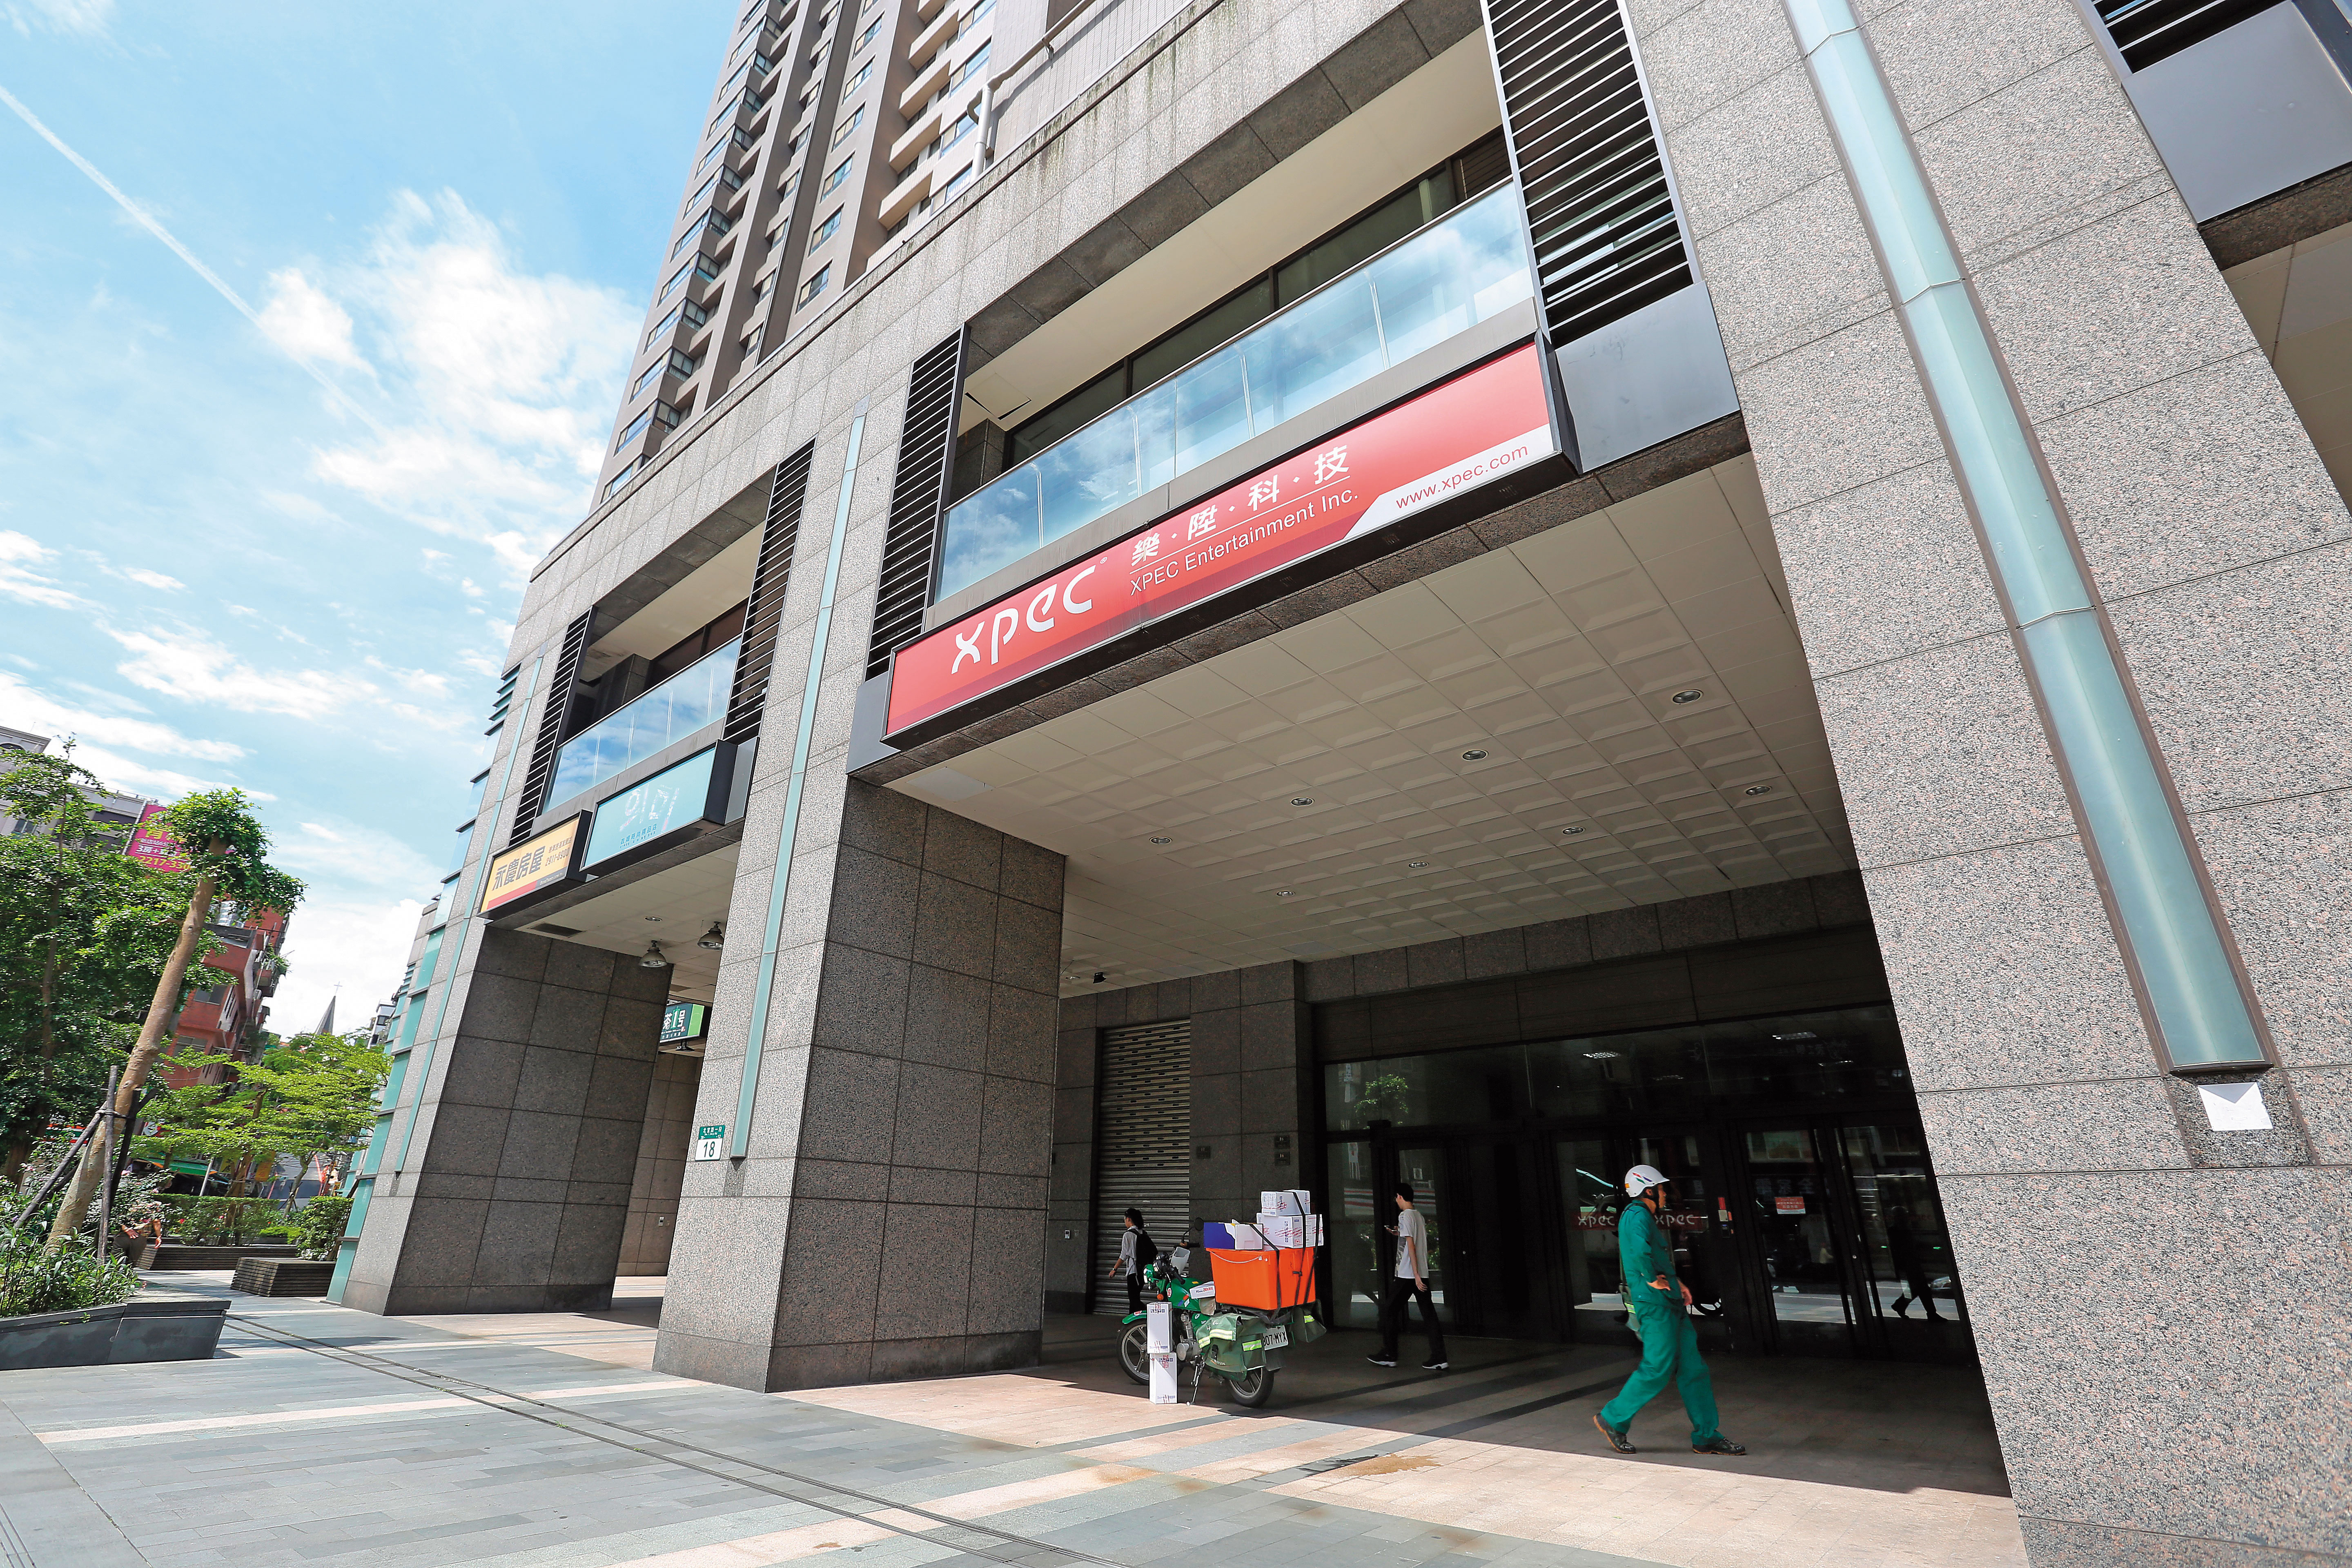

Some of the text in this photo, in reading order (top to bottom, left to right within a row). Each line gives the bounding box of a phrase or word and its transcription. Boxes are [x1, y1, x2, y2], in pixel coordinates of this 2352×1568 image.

[1396, 446, 1528, 509] www.xpec.com
[1130, 488, 1358, 596] XPEC Entertainment Inc.
[492, 846, 546, 891] 永慶房屋
[704, 1141, 715, 1157] 18
